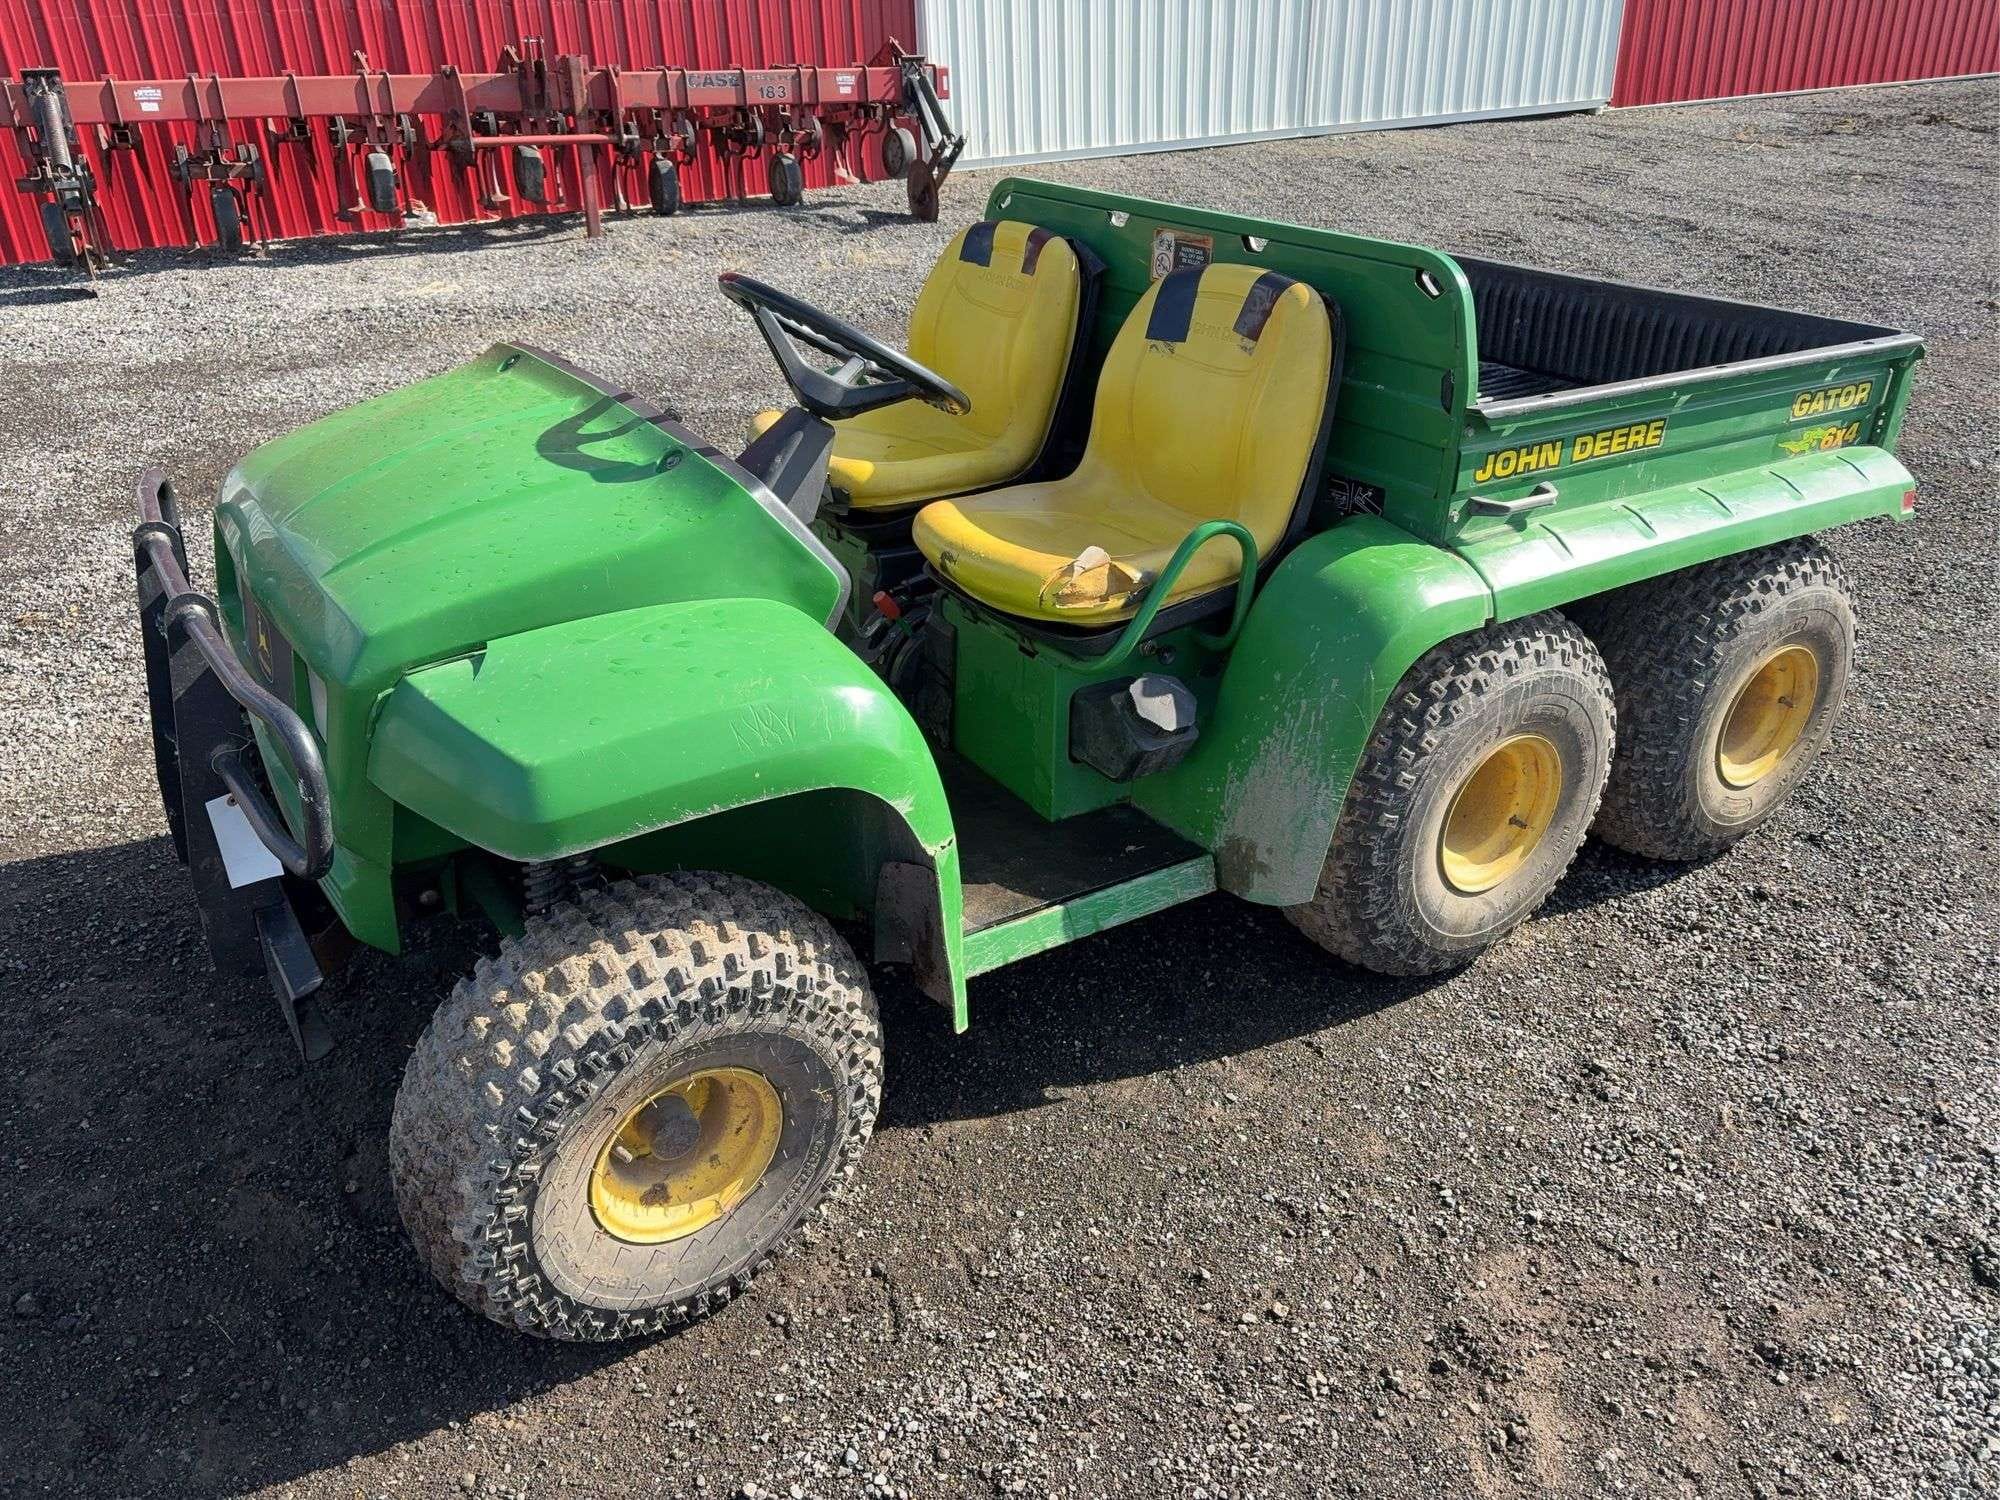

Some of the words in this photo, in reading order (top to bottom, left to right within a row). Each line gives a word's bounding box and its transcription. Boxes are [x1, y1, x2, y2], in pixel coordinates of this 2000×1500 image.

[688, 73, 741, 88] CASE
[759, 85, 787, 99] 183
[1793, 382, 1872, 417] GATOR
[1475, 440, 1563, 482] JOHN
[1572, 420, 1666, 462] DEERE
